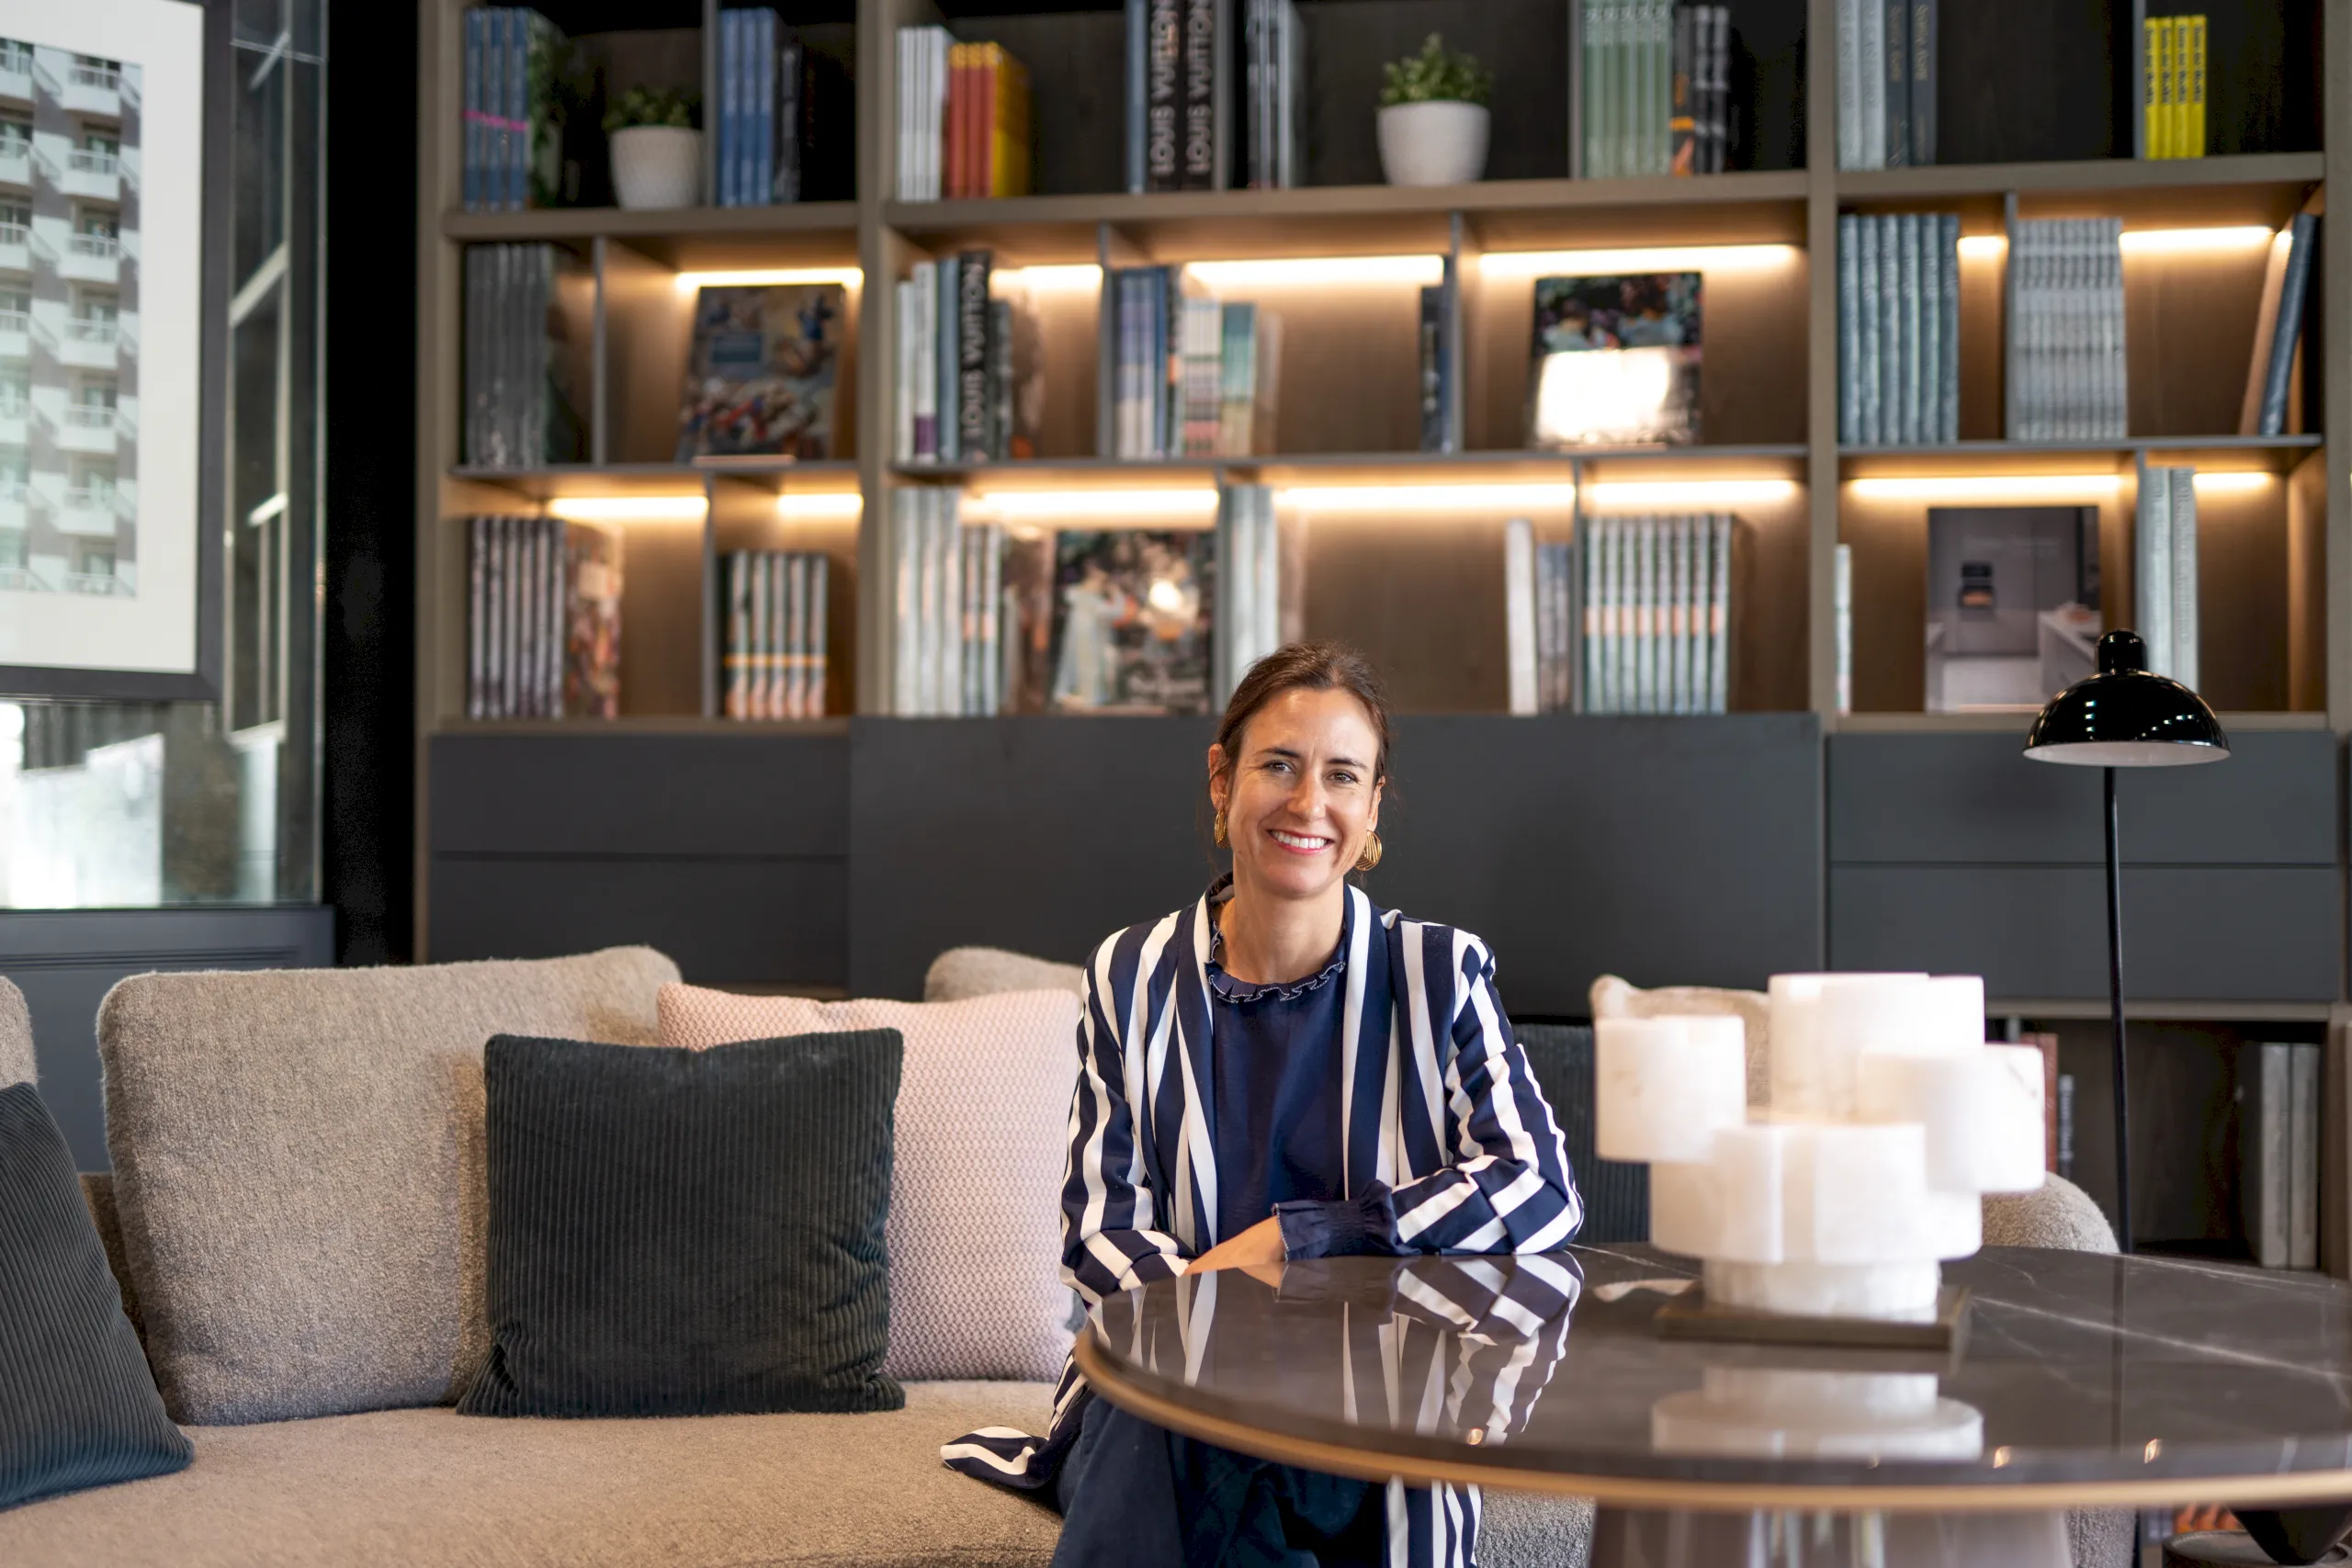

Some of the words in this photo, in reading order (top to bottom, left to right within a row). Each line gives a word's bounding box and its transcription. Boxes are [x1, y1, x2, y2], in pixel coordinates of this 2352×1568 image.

[1186, 0, 1213, 98] VUITTON
[1150, 106, 1175, 175] LOUIS
[1186, 105, 1212, 175] LOUIS
[961, 263, 985, 365] VUITTON
[961, 369, 985, 439] LOUIS
